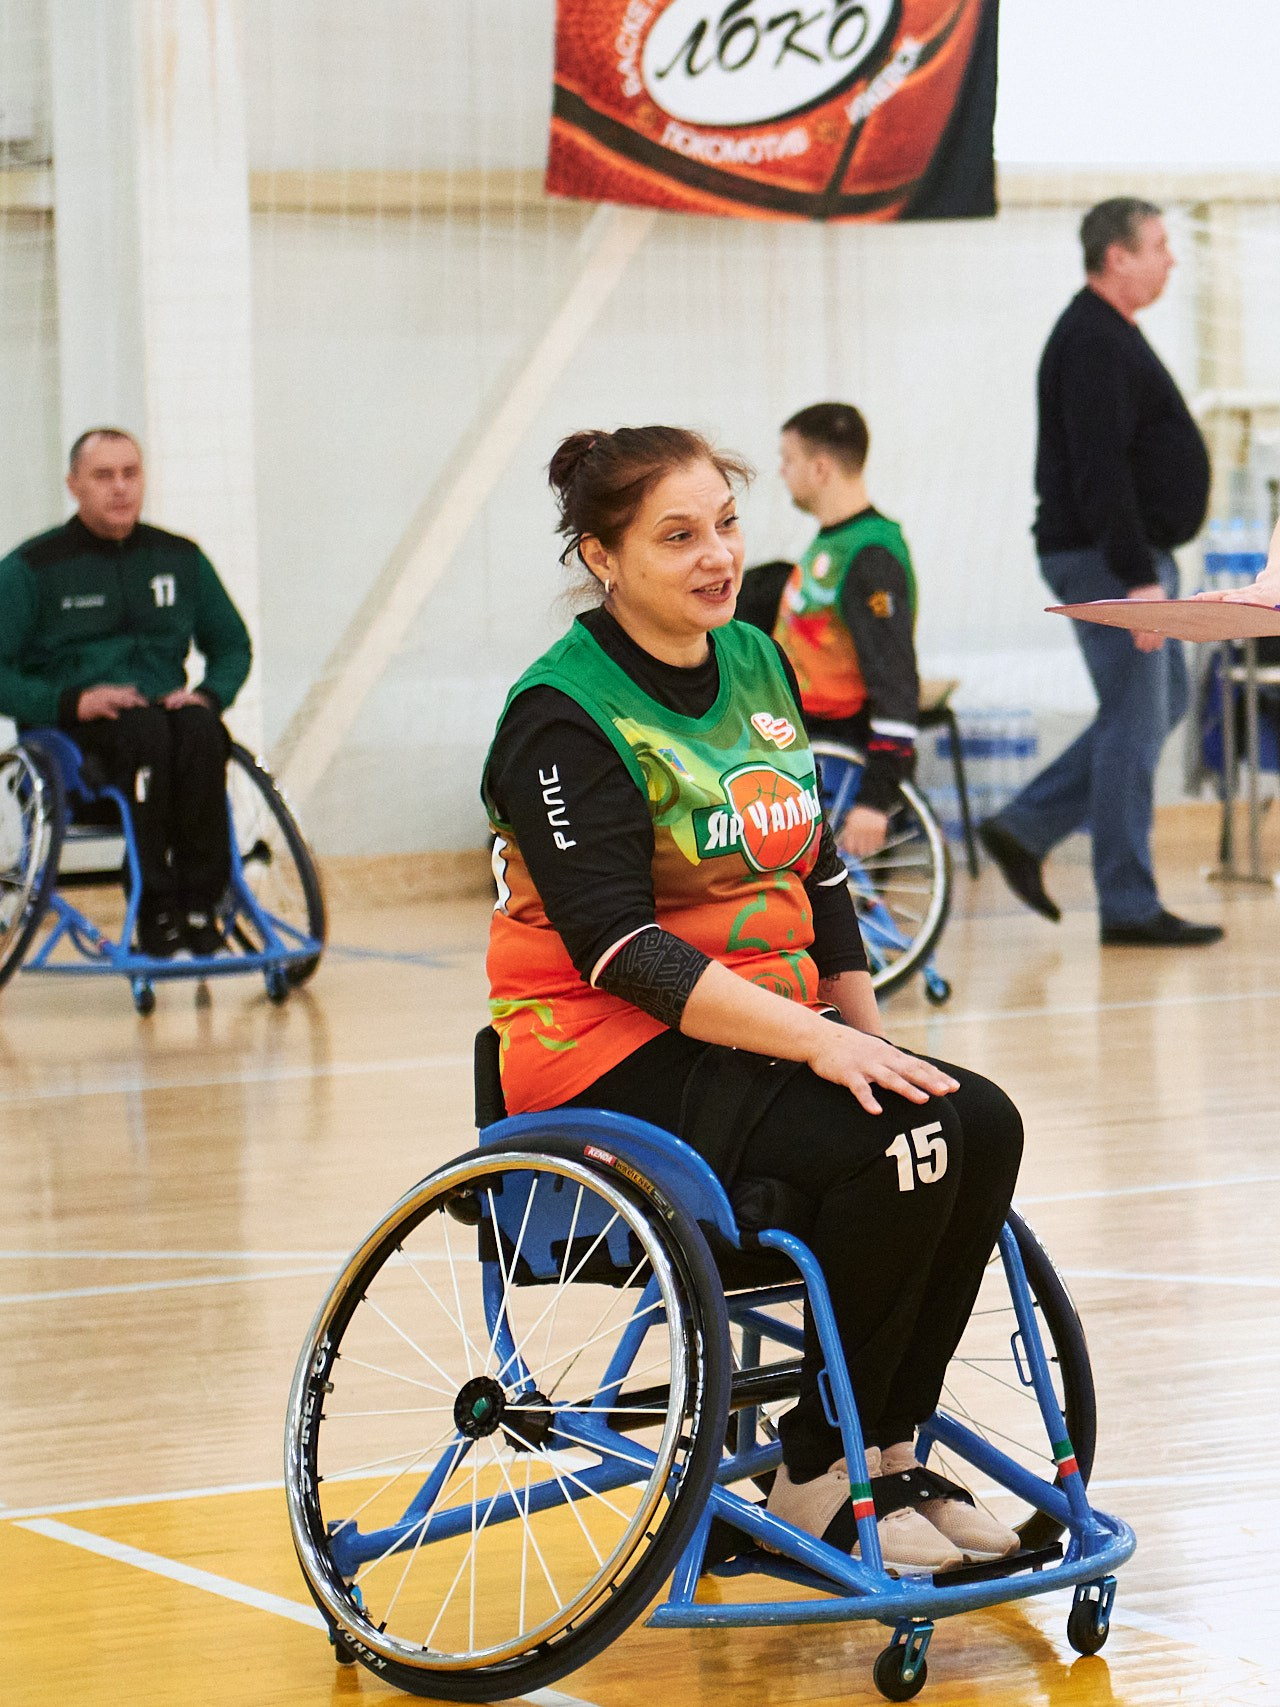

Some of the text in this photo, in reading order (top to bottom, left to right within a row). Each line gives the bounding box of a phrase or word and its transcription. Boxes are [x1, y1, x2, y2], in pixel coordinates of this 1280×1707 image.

[704, 810, 744, 850] ЯР
[885, 1121, 948, 1191] 15
[336, 1621, 387, 1670] KENDA
